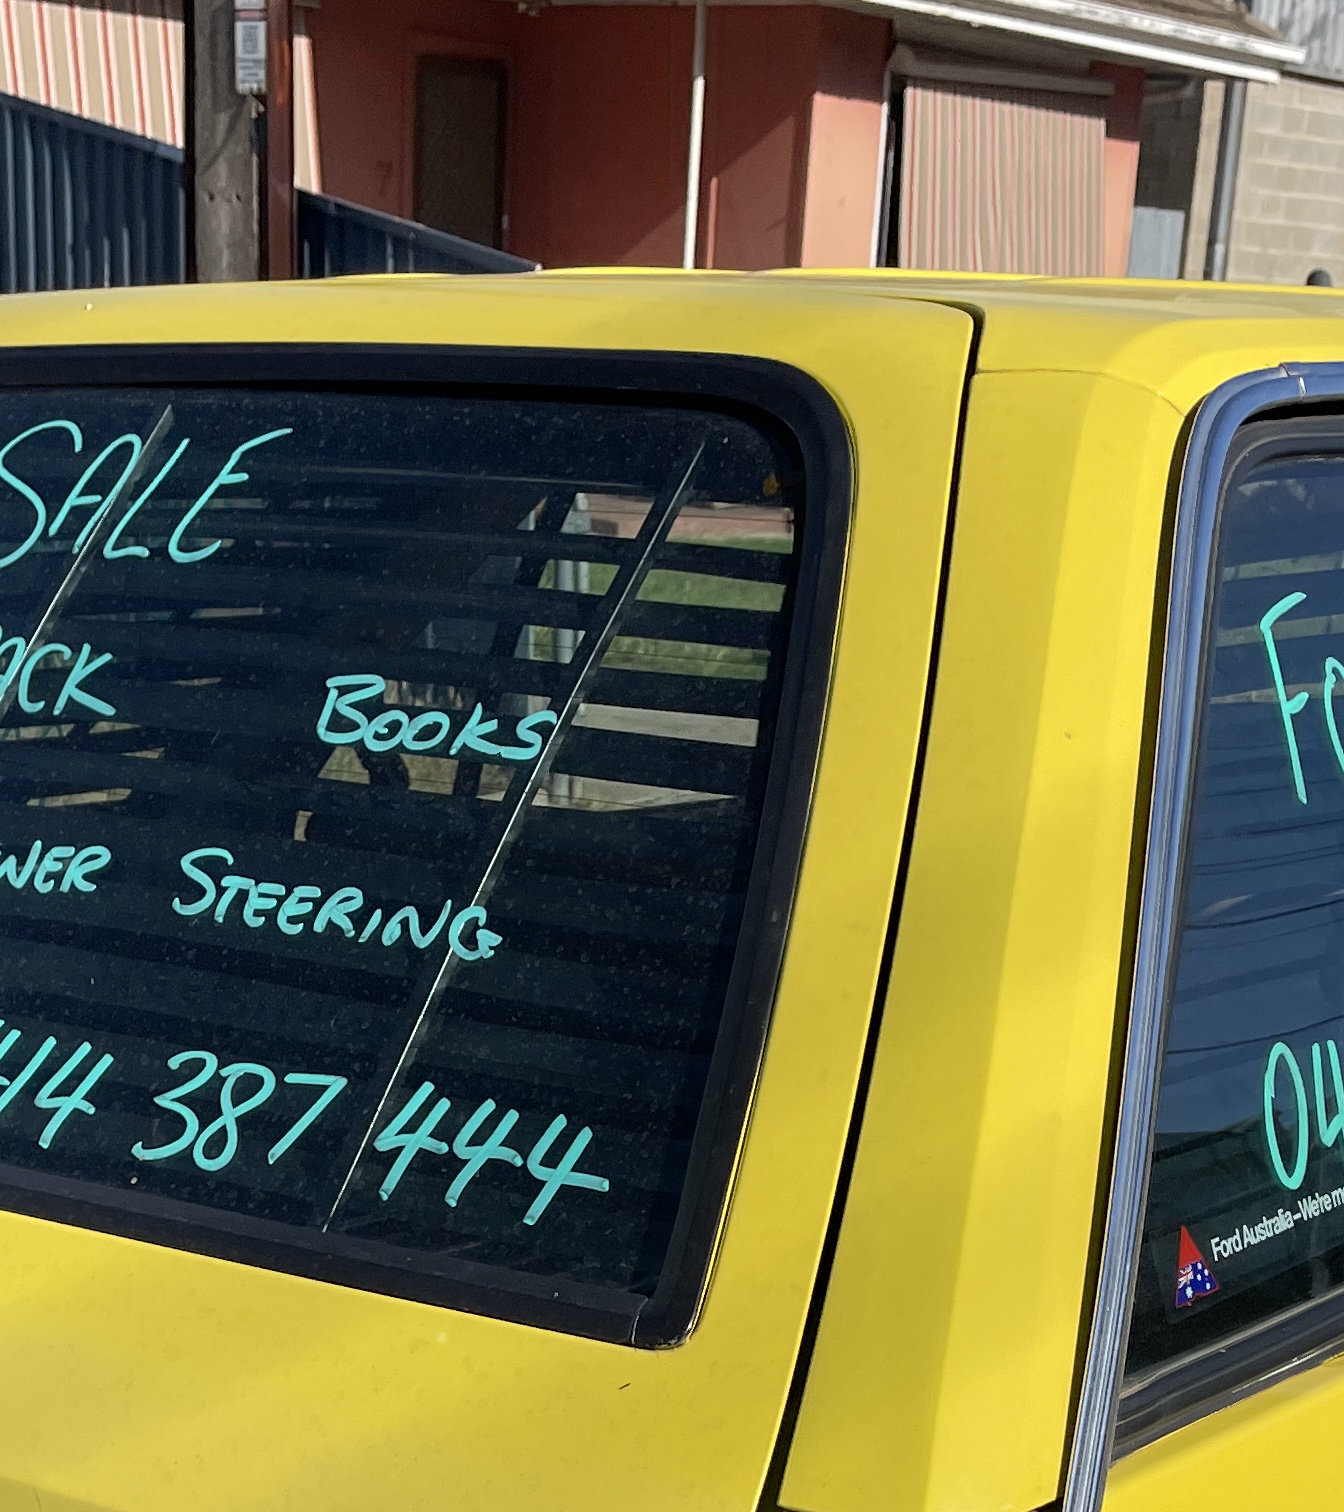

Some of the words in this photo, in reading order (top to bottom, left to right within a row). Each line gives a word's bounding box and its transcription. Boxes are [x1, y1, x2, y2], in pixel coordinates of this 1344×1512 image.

[171, 847, 503, 961] STEERING
[131, 1051, 348, 1171] 387
[373, 1081, 610, 1226] 444
